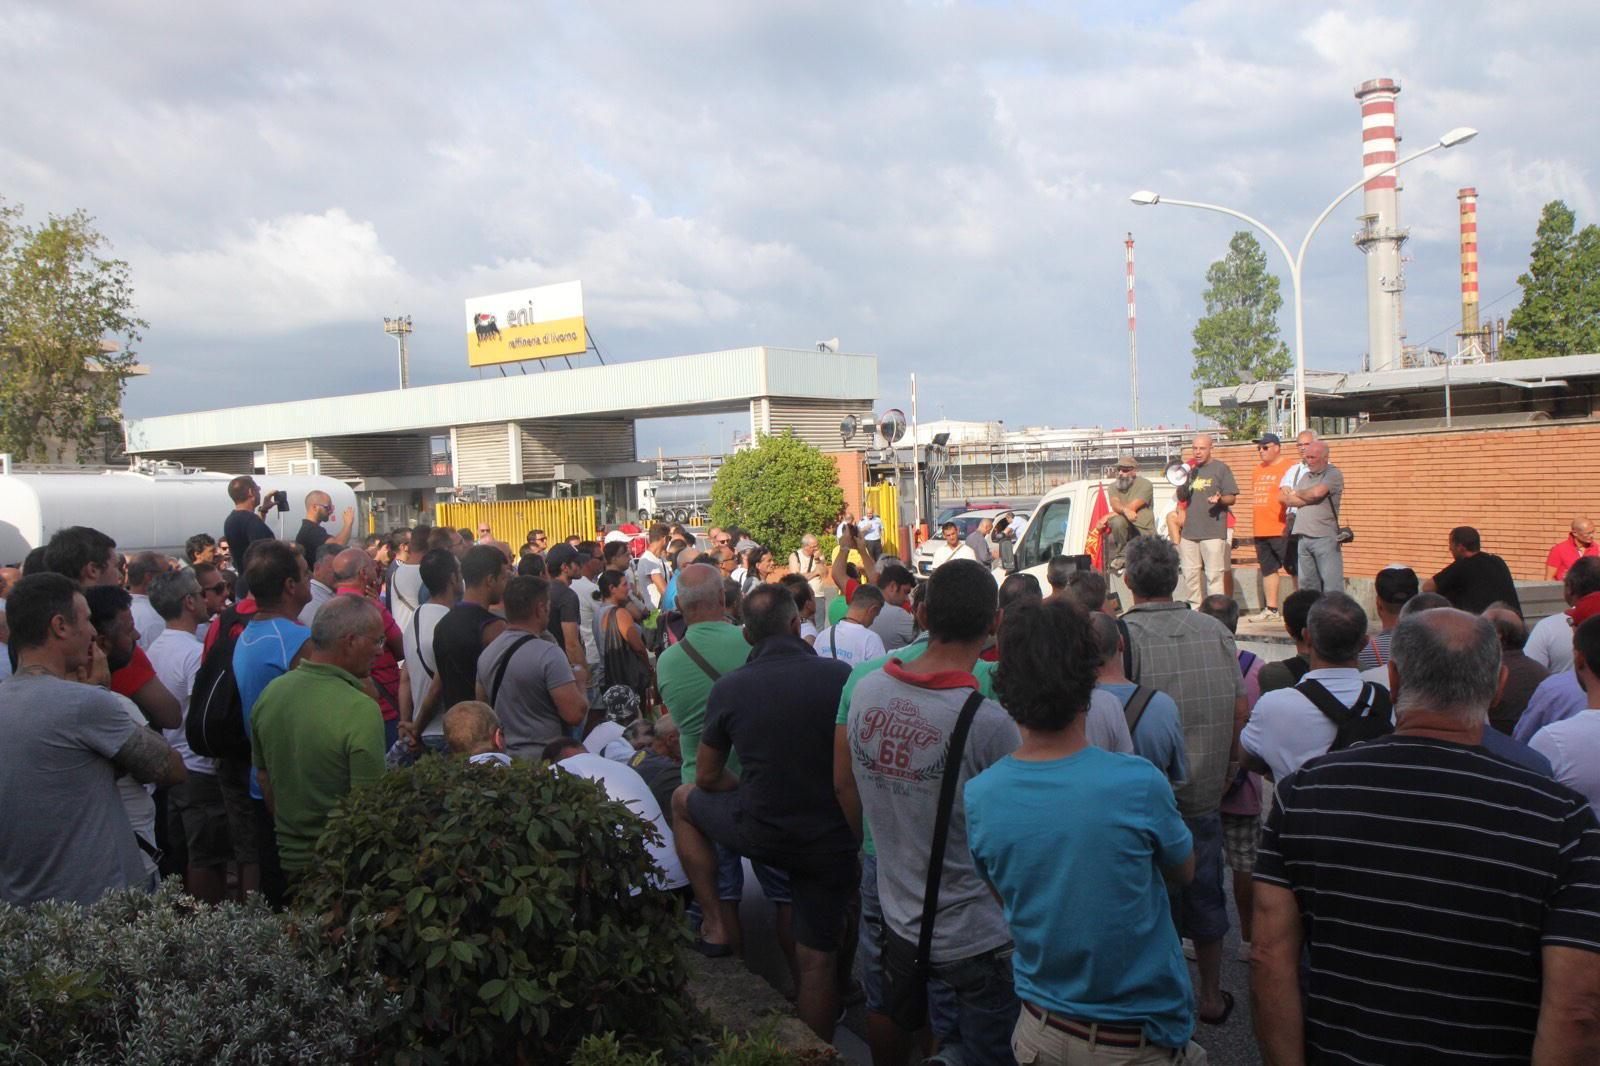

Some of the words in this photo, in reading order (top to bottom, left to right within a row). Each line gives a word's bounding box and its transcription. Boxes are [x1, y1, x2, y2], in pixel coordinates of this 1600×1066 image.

[507, 300, 534, 328] eni
[861, 708, 940, 749] Player
[880, 740, 910, 769] 66
